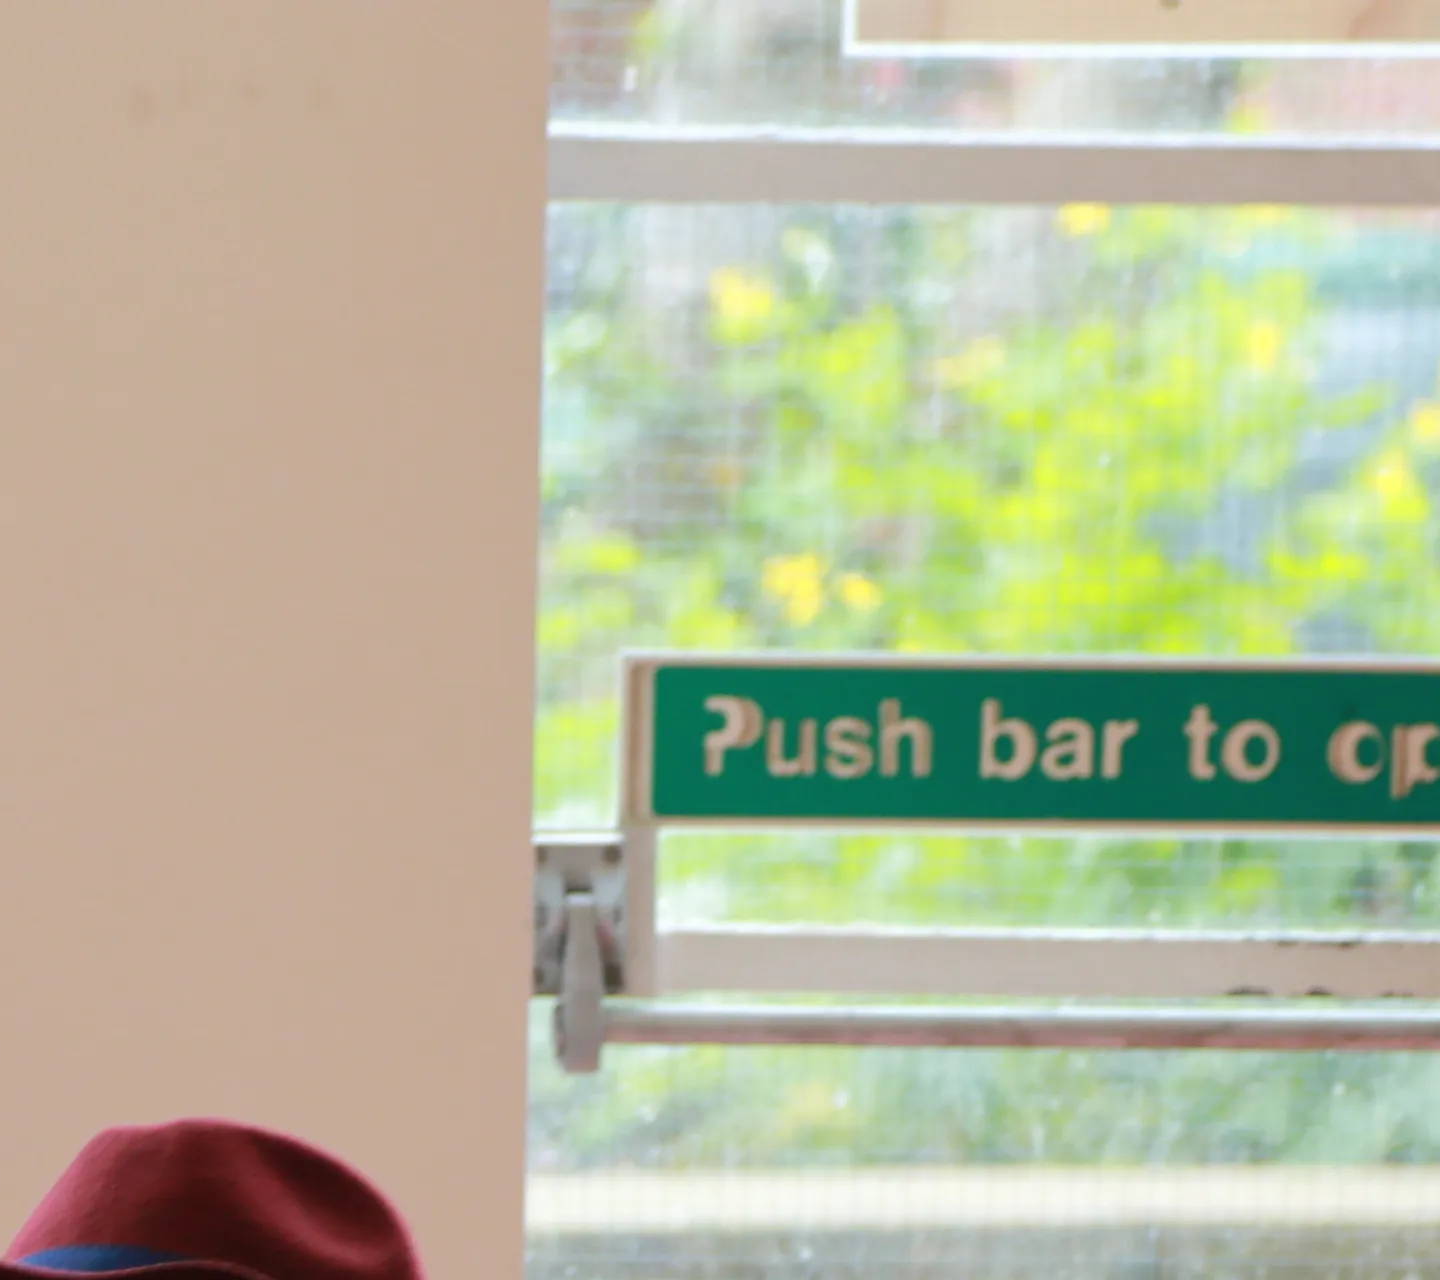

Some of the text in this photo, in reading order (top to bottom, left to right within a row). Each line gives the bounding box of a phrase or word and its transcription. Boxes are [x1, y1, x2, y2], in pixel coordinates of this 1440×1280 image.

[703, 695, 932, 779] Push
[980, 698, 1138, 781] bar
[1184, 704, 1282, 784] to
